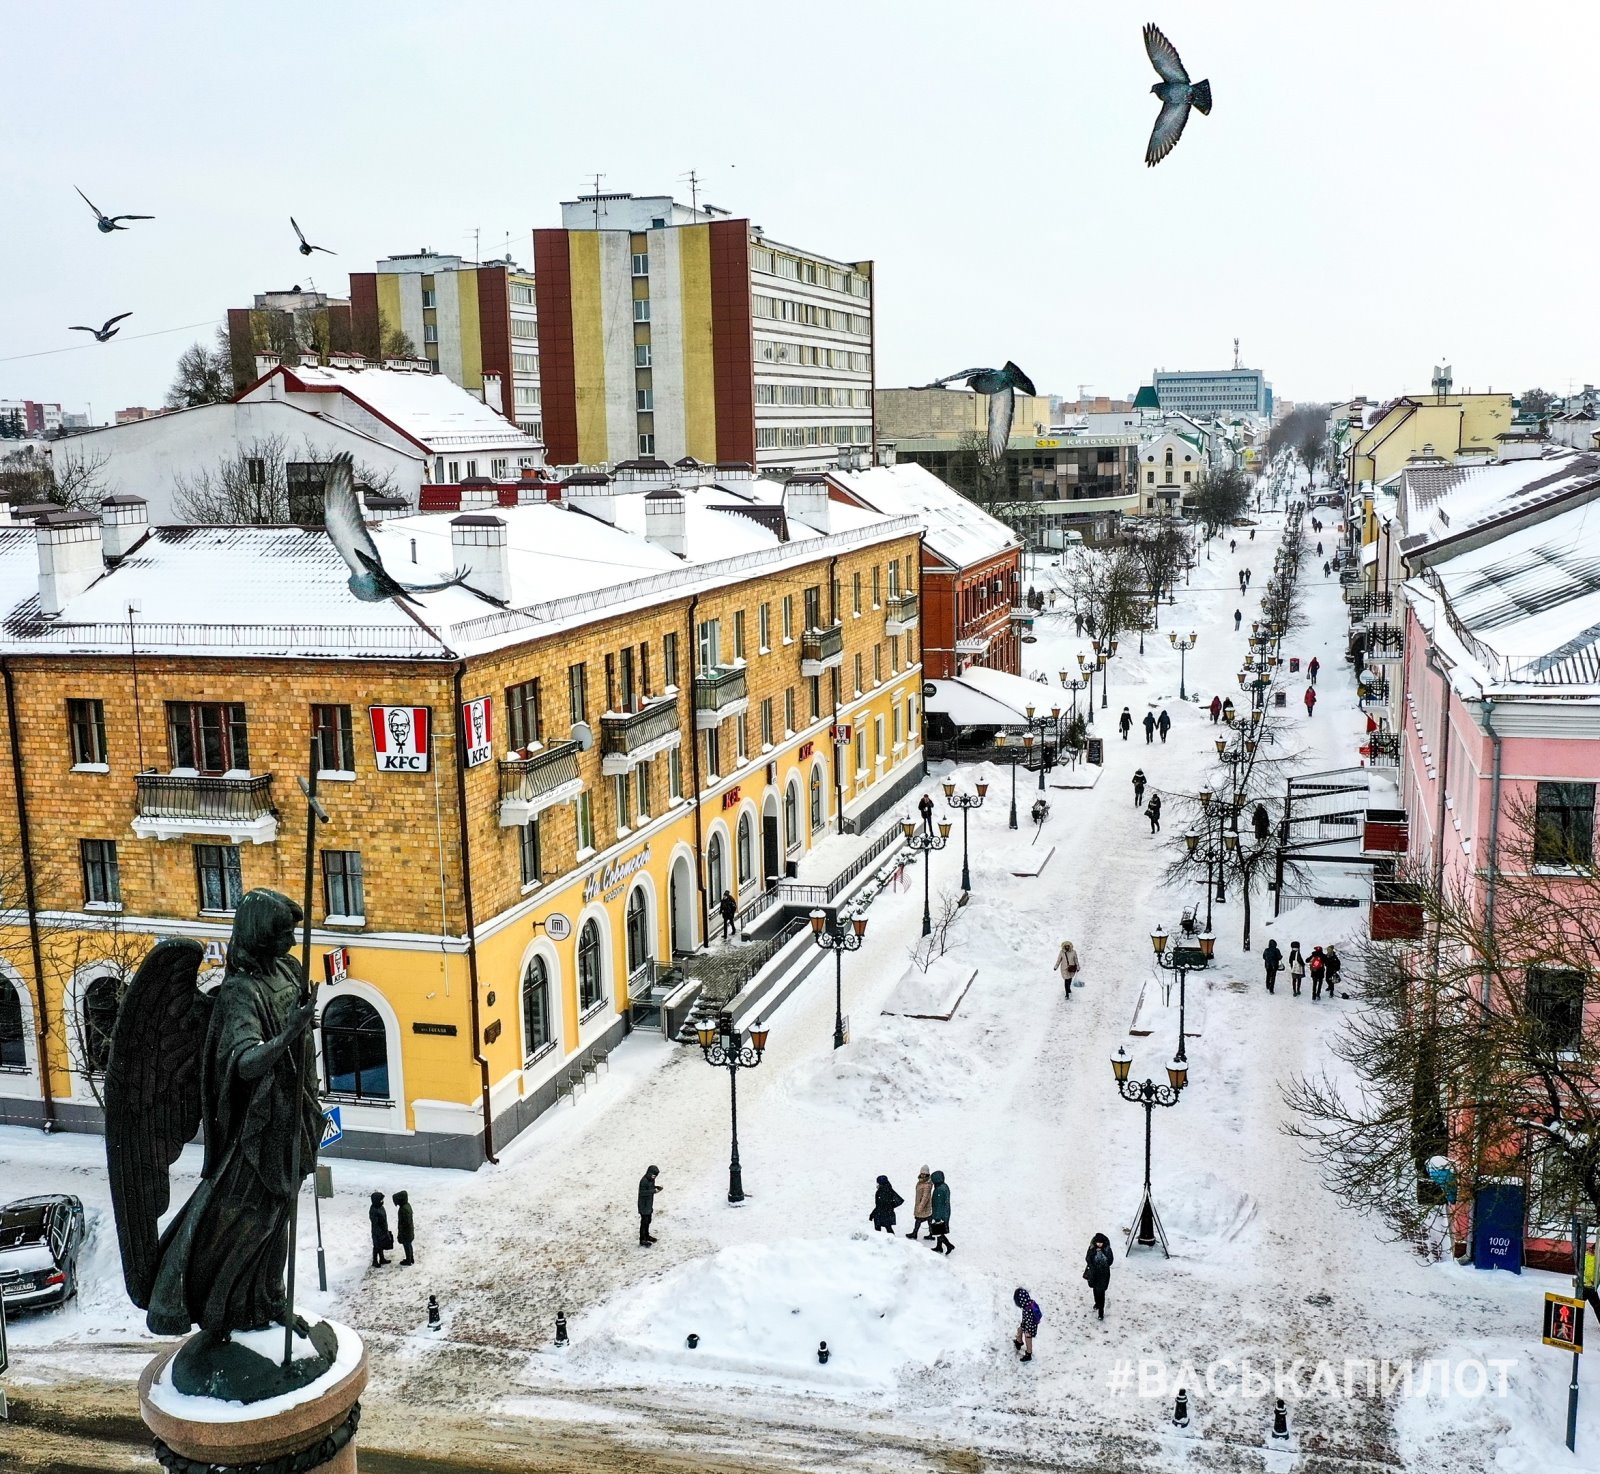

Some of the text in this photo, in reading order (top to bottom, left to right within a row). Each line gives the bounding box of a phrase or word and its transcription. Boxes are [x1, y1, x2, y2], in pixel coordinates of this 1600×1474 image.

[384, 755, 420, 769] KFC
[471, 746, 489, 764] KFC
[723, 785, 741, 810] KFC
[583, 843, 651, 902] На Советской
[334, 972, 347, 984] KFC
[1488, 1236, 1511, 1247] 1000
[1489, 1247, 1509, 1256] год!
